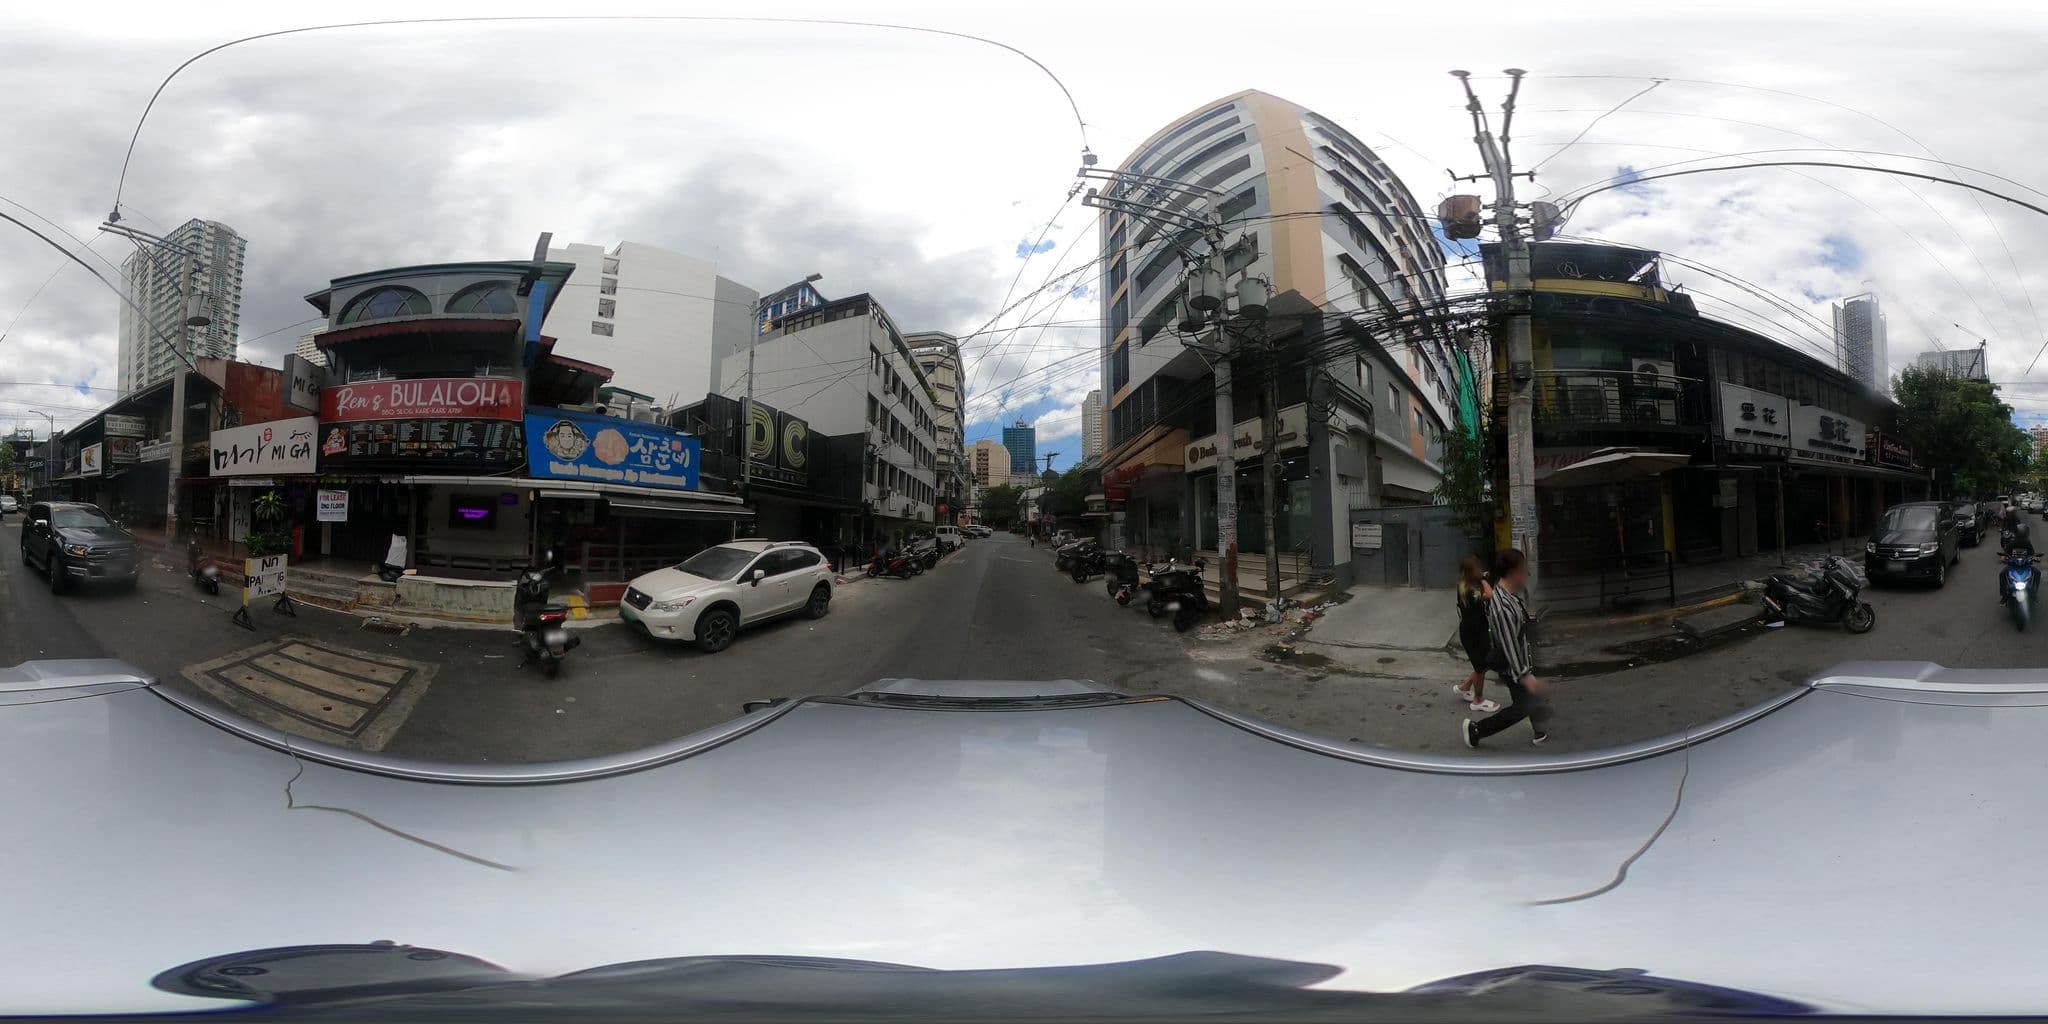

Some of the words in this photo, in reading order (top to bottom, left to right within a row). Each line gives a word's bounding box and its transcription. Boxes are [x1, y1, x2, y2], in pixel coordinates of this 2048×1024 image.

[293, 376, 305, 393] MI
[336, 386, 385, 417] Ren's
[271, 445, 286, 461] MI
[290, 442, 311, 460] GA
